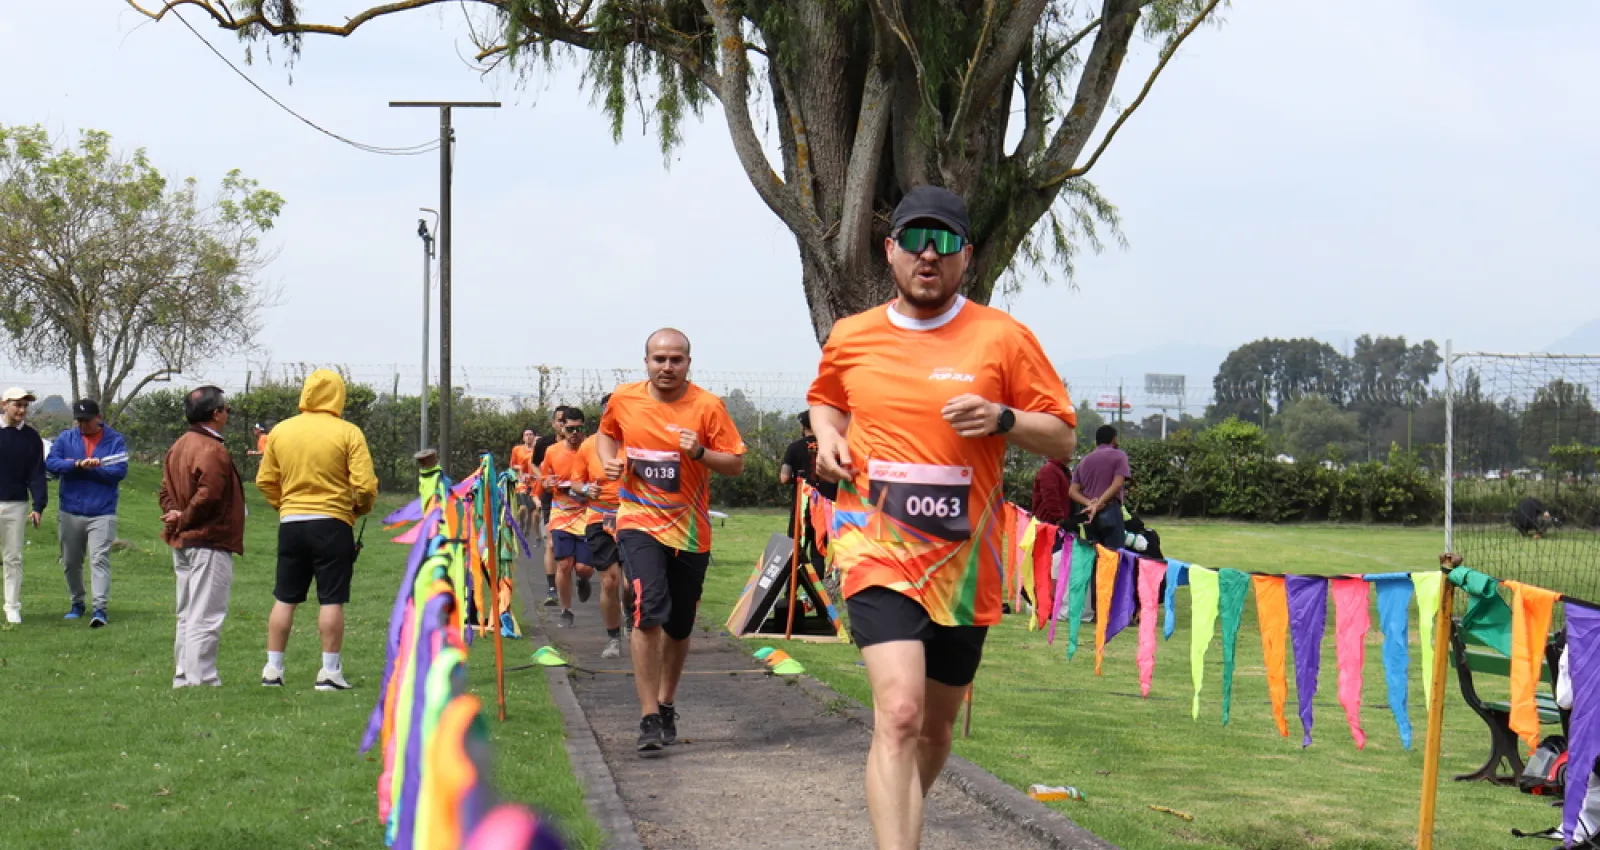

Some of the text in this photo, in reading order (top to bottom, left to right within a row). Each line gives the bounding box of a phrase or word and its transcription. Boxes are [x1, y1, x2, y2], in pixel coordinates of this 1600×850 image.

[928, 372, 976, 382] POP RUN
[645, 466, 675, 479] 0138
[906, 495, 961, 518] 0063
